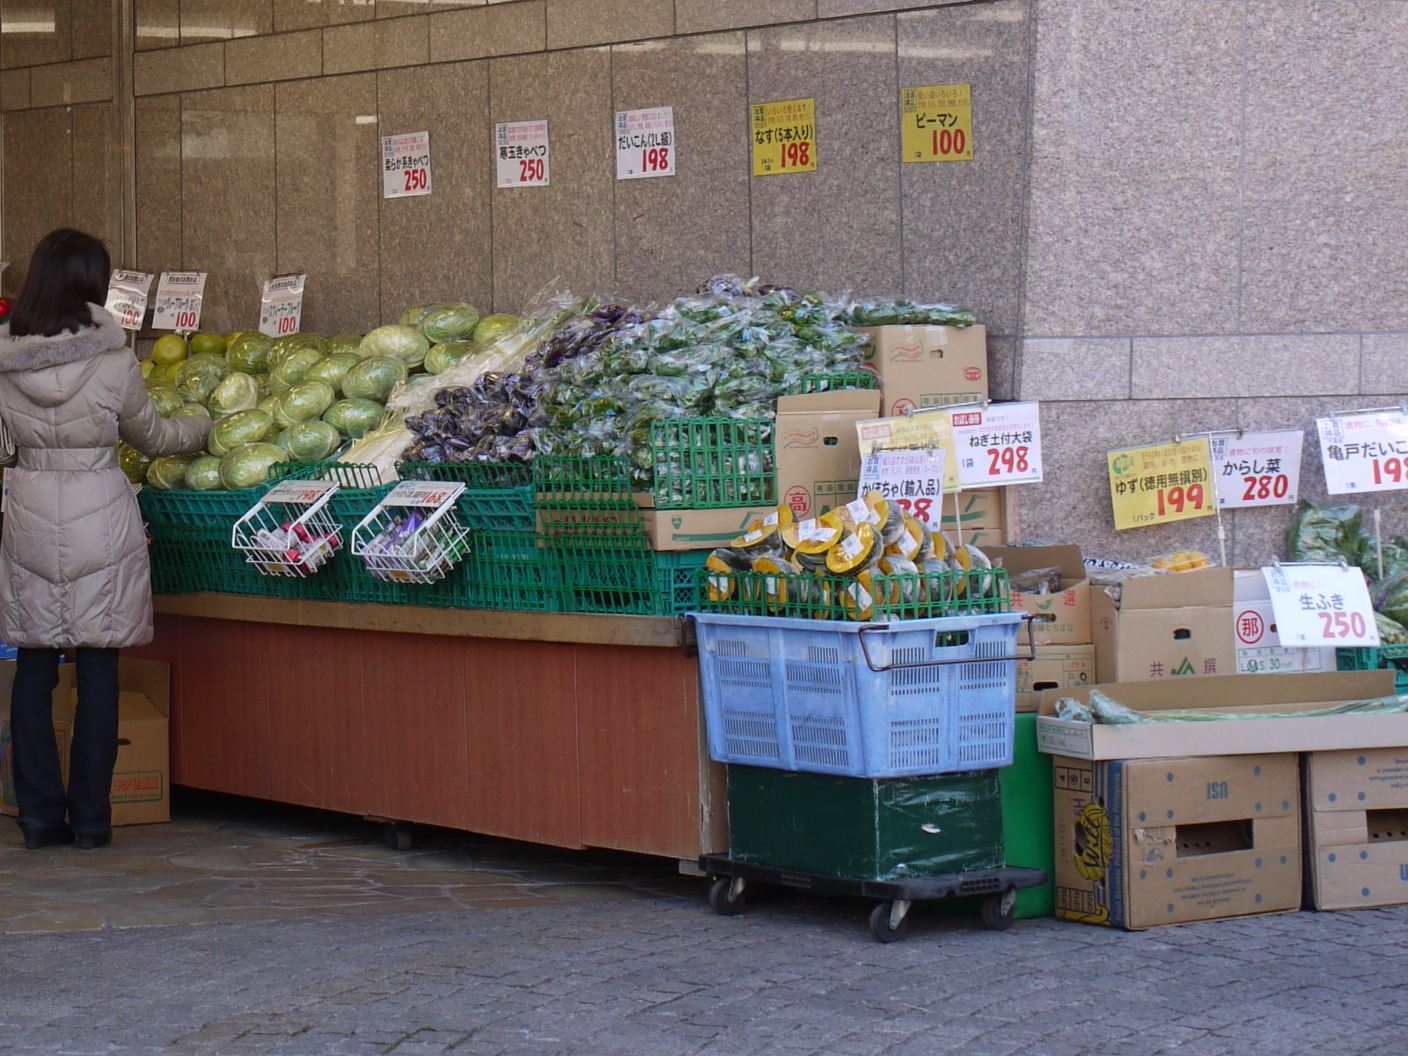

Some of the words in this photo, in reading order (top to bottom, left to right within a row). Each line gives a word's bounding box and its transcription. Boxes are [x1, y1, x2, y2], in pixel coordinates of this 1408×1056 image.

[915, 112, 959, 129] ピーマン
[618, 131, 673, 150] だいこん(2L級)
[754, 124, 813, 144] なす(5本入り)
[932, 128, 966, 156] 100
[499, 144, 547, 160] 寒玉きゃべつ
[641, 147, 669, 173] 198
[780, 141, 810, 169] 198
[403, 168, 427, 192] 250
[519, 158, 545, 182] 250
[175, 311, 197, 328] 100
[277, 315, 296, 334] 100
[969, 431, 1033, 448] ねぎ土付大袋
[1326, 440, 1408, 461] 亀戸だいこ
[986, 445, 1029, 476] 298
[1222, 457, 1282, 477] からし菜
[1115, 467, 1209, 496] ゆず(徳用無撰別)
[1241, 473, 1289, 501] 280
[790, 491, 807, 513] 高
[1156, 483, 1205, 517] 199
[1010, 591, 1024, 608] 共
[1063, 589, 1077, 607] 選
[1299, 593, 1344, 611] 生ふき
[1241, 616, 1259, 637] 那
[1317, 611, 1366, 639] 250
[1150, 661, 1164, 677] 共
[1113, 772, 1122, 814] Philippines
[1113, 837, 1122, 867] Product
[1113, 868, 1123, 900] Bananas
